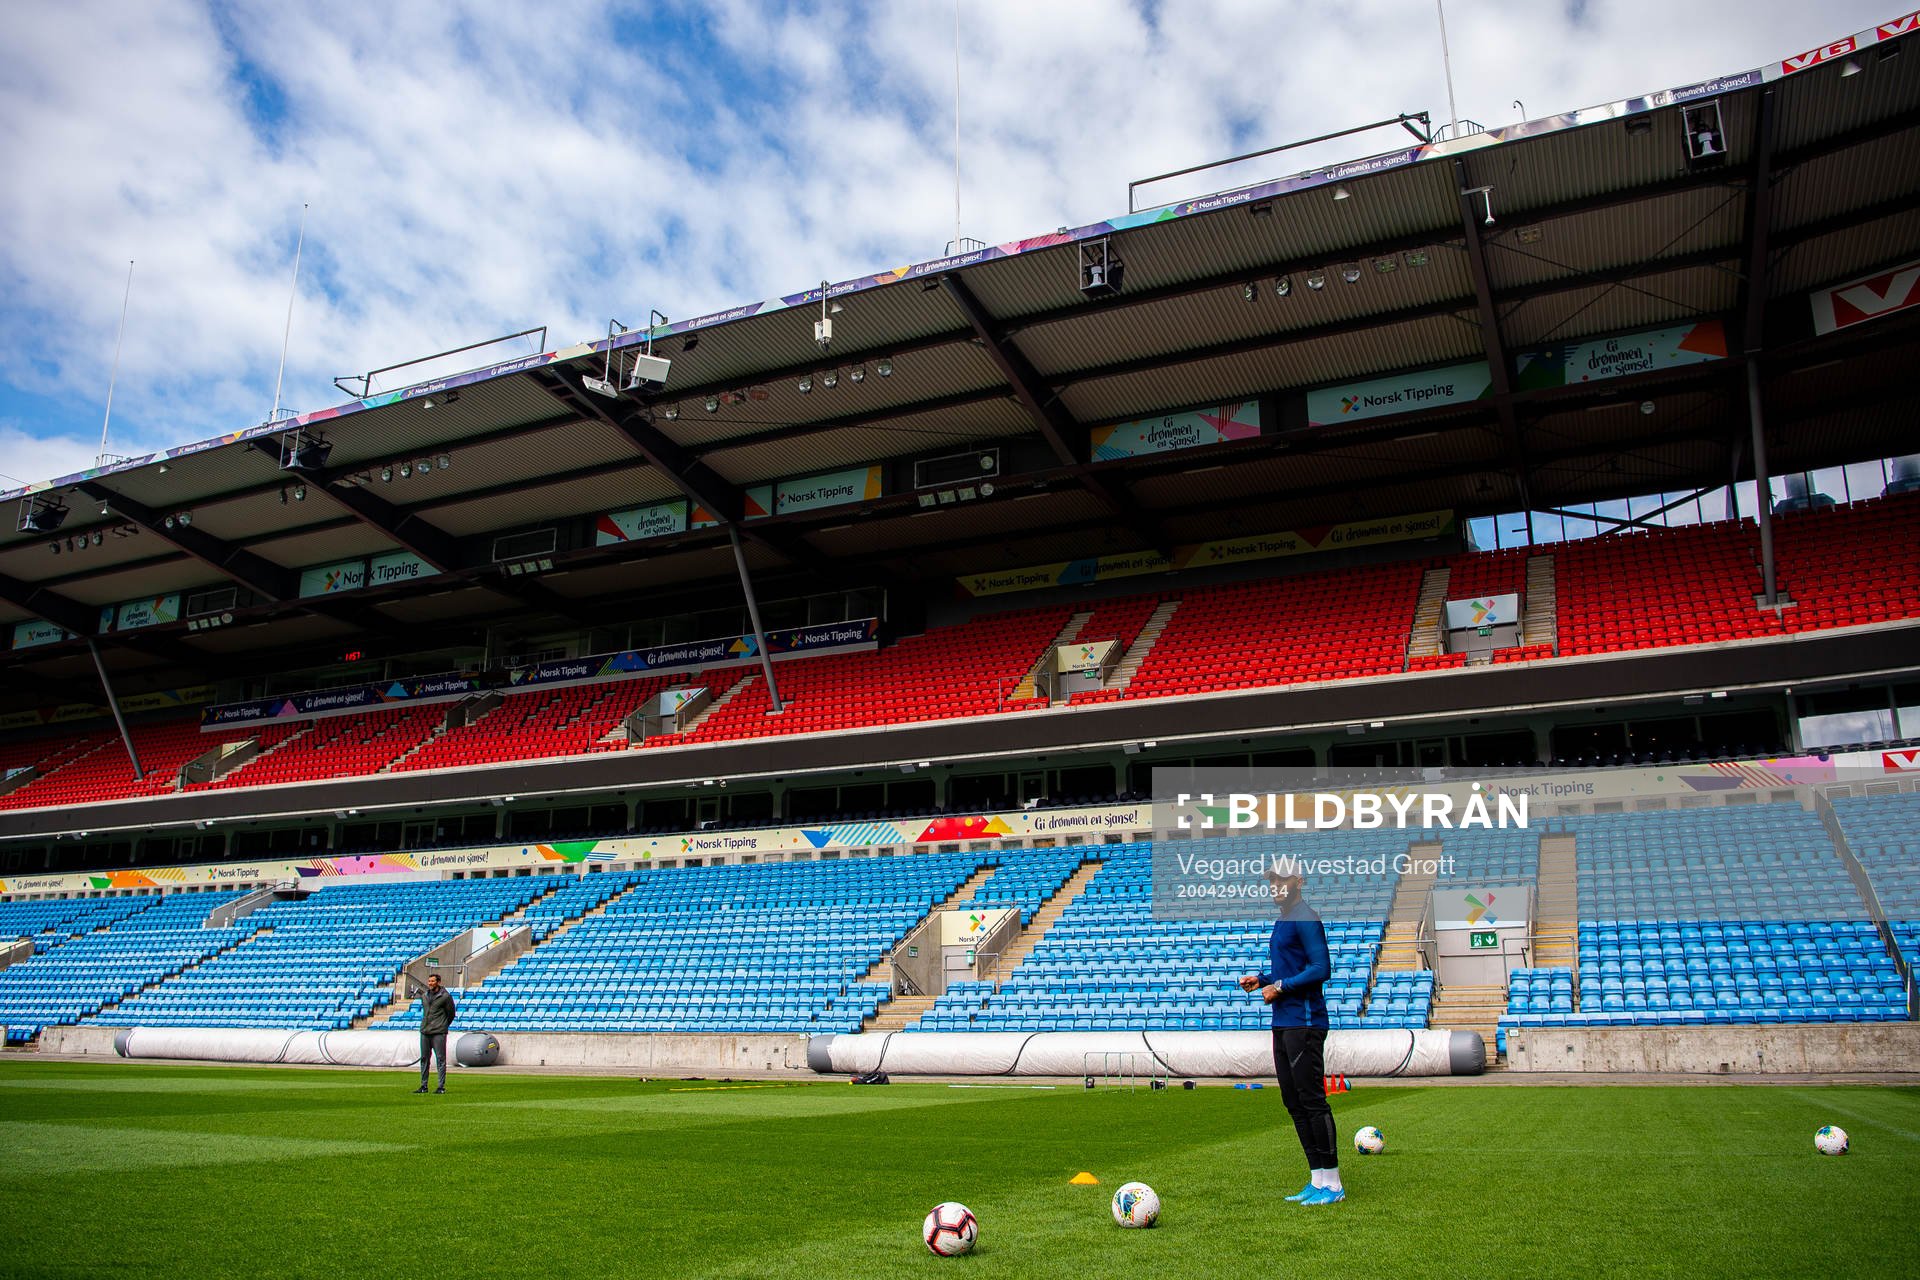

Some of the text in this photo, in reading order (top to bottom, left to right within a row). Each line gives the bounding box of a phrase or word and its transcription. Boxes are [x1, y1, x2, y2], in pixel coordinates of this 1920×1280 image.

[1880, 13, 1920, 35] V
[1784, 40, 1850, 69] VG
[1707, 83, 1719, 92] en
[1720, 74, 1752, 91] sjanse!
[1372, 160, 1381, 169] en
[1382, 152, 1411, 166] sjanse!
[1199, 193, 1250, 209] Norsk Tipping
[915, 264, 924, 274] Gi
[952, 257, 960, 265] en
[813, 283, 855, 298] Nok Tipping
[688, 320, 696, 328] Gi
[1606, 340, 1618, 352] Gi
[1588, 348, 1643, 370] drømmen
[1600, 353, 1653, 376] en sjanse!
[1364, 384, 1454, 407] Norsk Tipping
[1164, 417, 1173, 428] Gi
[1148, 424, 1192, 444] drømmen
[1157, 429, 1200, 450] en sjanse!
[788, 485, 854, 503] Norsk Tipping
[650, 506, 658, 517] Gi
[1331, 529, 1342, 543] Gi
[1227, 540, 1296, 555] Norsk Tipping
[343, 562, 419, 585] Nork Tipping
[989, 573, 1049, 587] Norsk Tipping
[805, 629, 863, 644] Norsk Tipping
[647, 643, 724, 665] Gi drømmen en sjanse!
[540, 665, 587, 678] Norsk Tipping
[425, 680, 468, 692] Norsk Tipping
[306, 699, 312, 708] Gi
[337, 694, 345, 703] en
[224, 707, 260, 718] Norsk Tipping
[1499, 781, 1594, 797] Norsk Tipping
[1034, 810, 1138, 830] Gi drømmen en sjanse!
[696, 837, 757, 850] Norsk Tipping
[421, 855, 429, 866] Gi
[457, 855, 466, 864] en
[466, 851, 489, 866] sjanse!
[218, 867, 259, 878] Norsk Tipping
